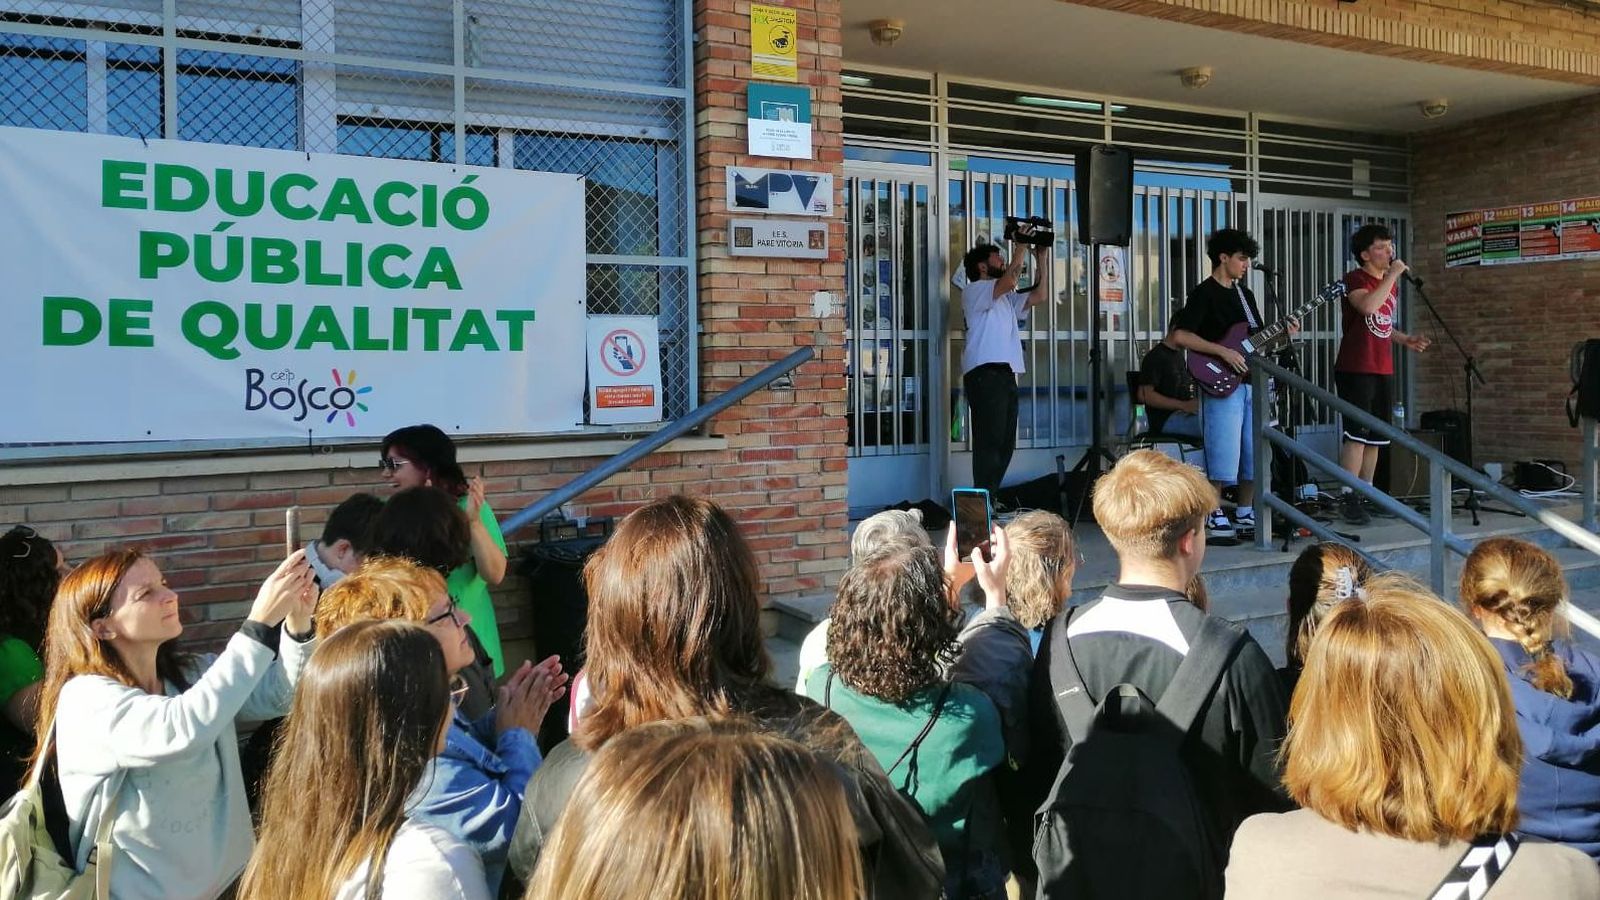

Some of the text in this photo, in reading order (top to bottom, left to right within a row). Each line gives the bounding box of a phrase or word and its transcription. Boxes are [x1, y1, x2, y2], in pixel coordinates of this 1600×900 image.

[102, 160, 490, 230] EDUCACIÓ
[1521, 206, 1535, 218] 13
[1562, 201, 1576, 213] 14
[1483, 210, 1496, 221] 12
[1446, 216, 1458, 230] 11
[757, 239, 804, 249] PARE VITORIA
[139, 222, 462, 290] PÚBLICA
[42, 296, 535, 360] DE QUALITAT
[270, 368, 295, 386] ceip
